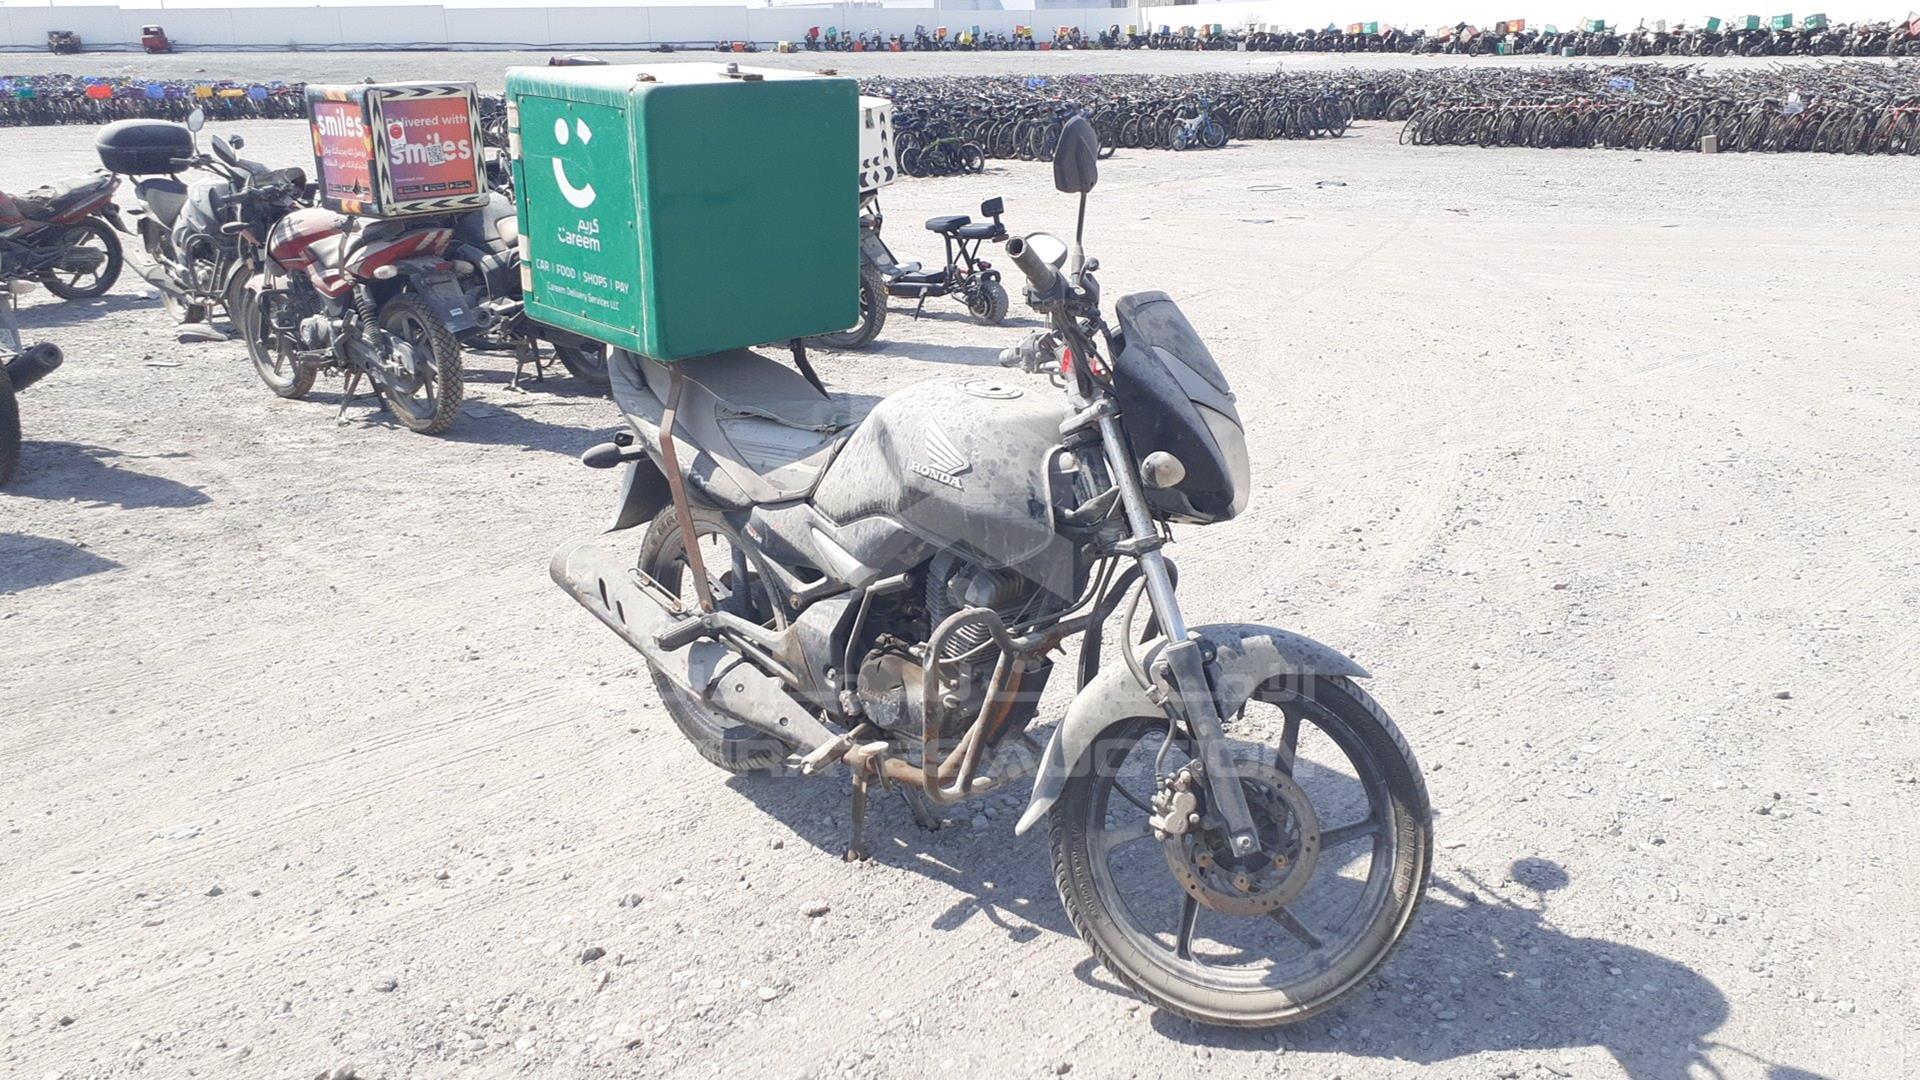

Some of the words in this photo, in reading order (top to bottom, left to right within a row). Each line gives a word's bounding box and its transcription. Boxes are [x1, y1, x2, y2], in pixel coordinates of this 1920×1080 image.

[317, 106, 364, 138] smiles
[385, 115, 439, 128] Dlivered
[442, 113, 468, 126] with
[557, 226, 601, 252] Careem
[577, 218, 600, 235] كريم
[535, 258, 550, 272] CAR
[556, 264, 576, 279] FOOD
[582, 271, 608, 288] SHOPS
[615, 280, 630, 294] PAY
[547, 281, 566, 294] Careem
[910, 461, 963, 489] HONDA
